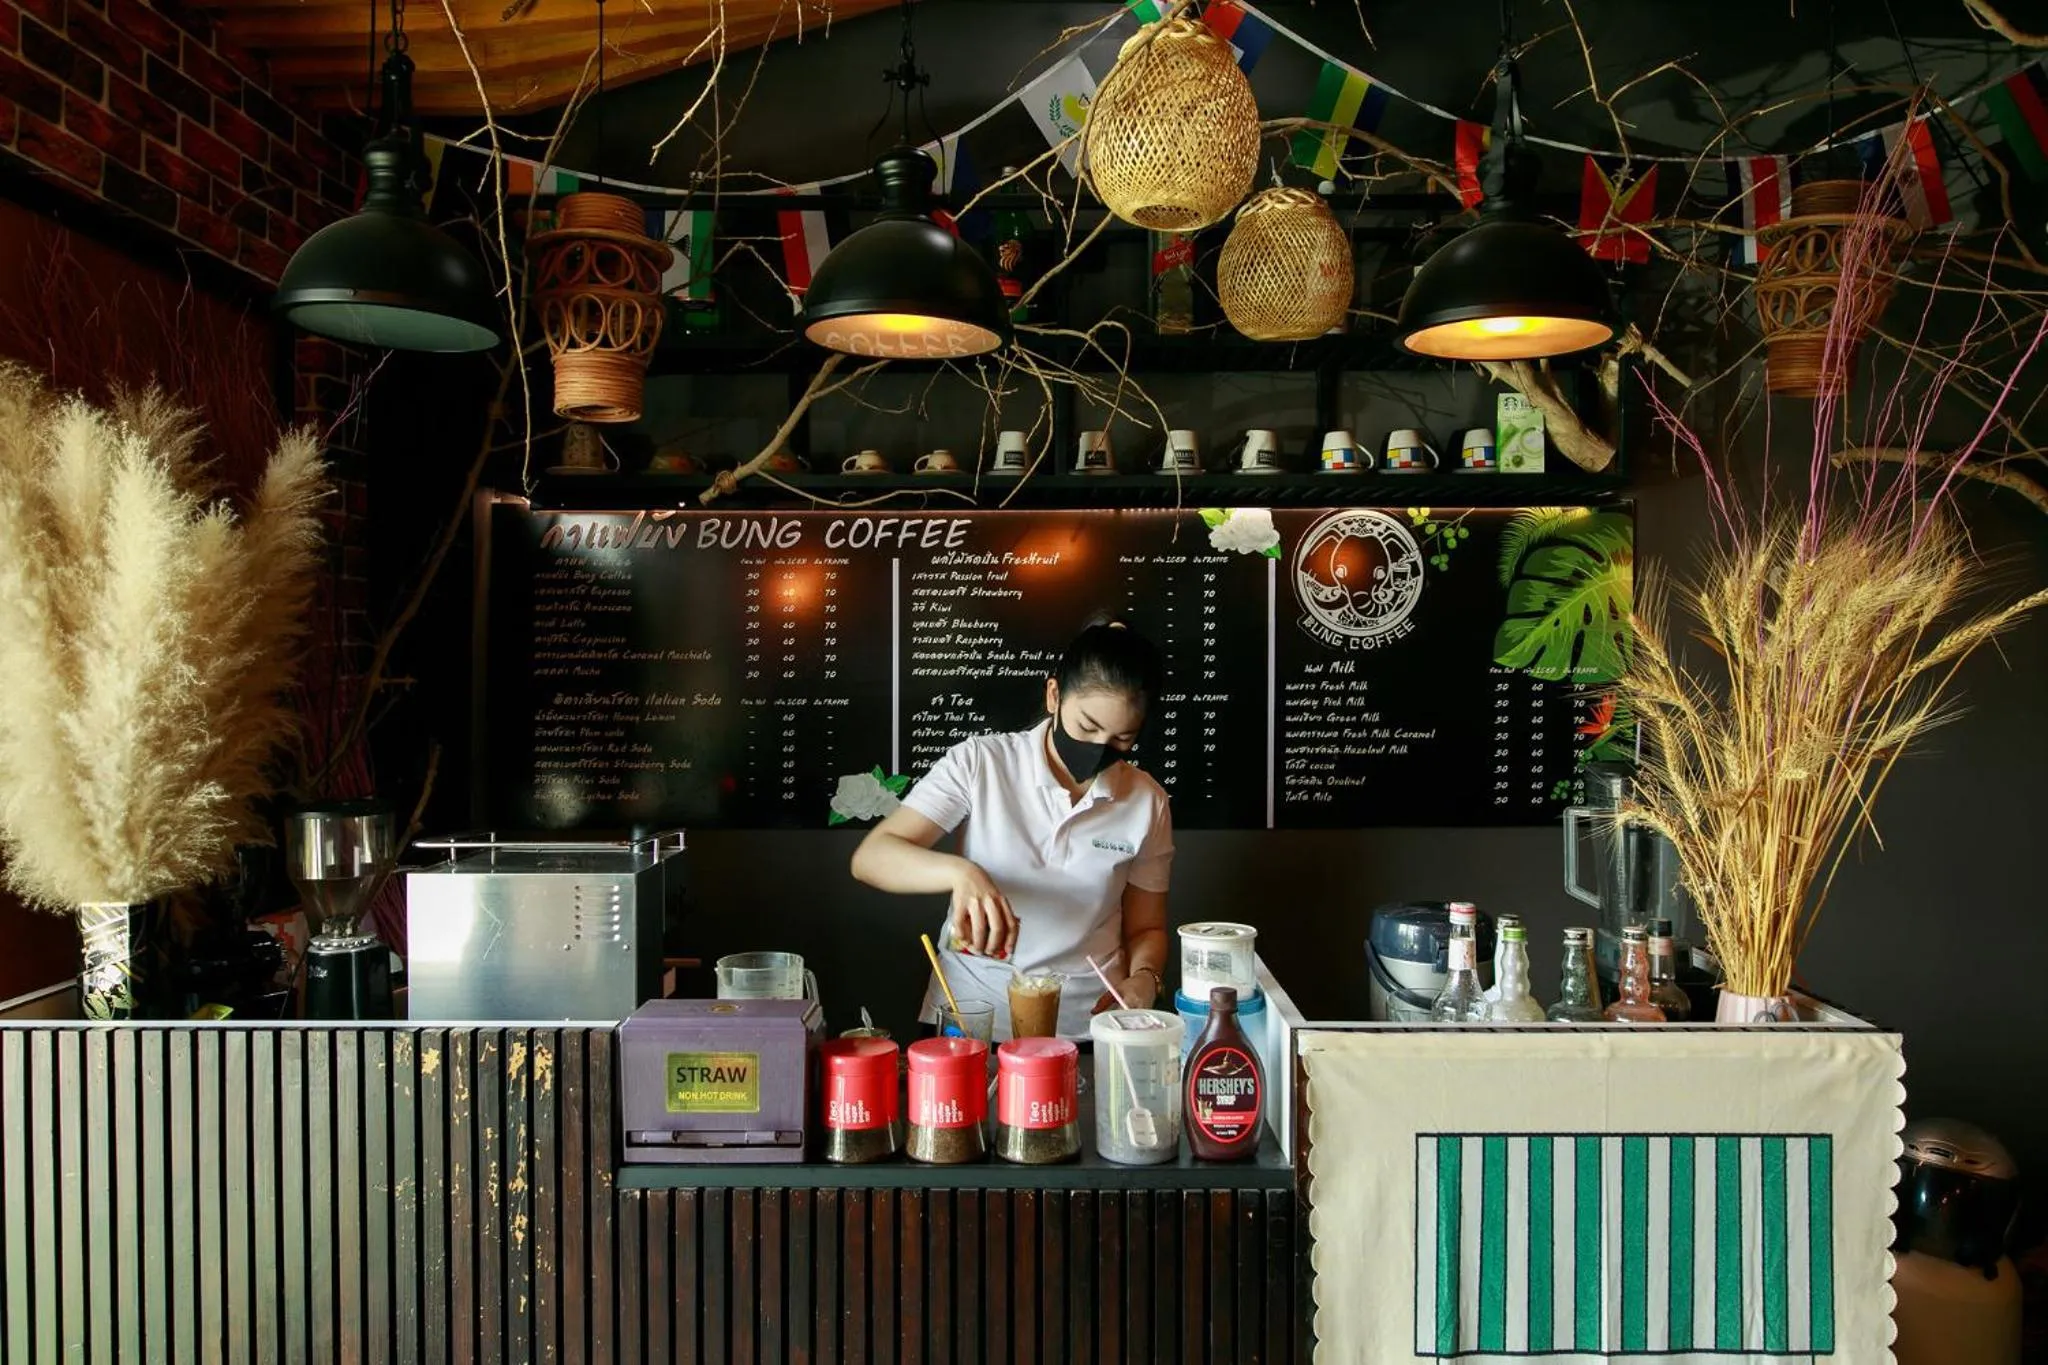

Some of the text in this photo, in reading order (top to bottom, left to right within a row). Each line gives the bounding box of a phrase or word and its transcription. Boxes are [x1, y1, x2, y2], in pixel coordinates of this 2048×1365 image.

[697, 518, 802, 550] BUNG
[826, 518, 972, 549] COFFEE
[950, 571, 982, 580] Passion
[970, 587, 1023, 600] Strawberry
[1203, 590, 1215, 598] 70
[930, 602, 952, 612] Kiwi
[1203, 606, 1215, 614] 70
[560, 618, 586, 628] Latte
[746, 621, 836, 629] 50 60 70
[951, 618, 998, 631] Blueberry
[1203, 622, 1215, 630] 70
[1302, 614, 1343, 646] BUNG
[1350, 618, 1416, 650] COFFEE
[746, 637, 836, 646] 50 60 70
[955, 634, 1003, 648] Raspberry
[1203, 638, 1215, 646] 70
[622, 650, 664, 660] Caramel
[746, 654, 836, 662] 50 60 70
[987, 650, 1015, 660] Snake
[1020, 651, 1042, 660] Fruit
[1046, 652, 1054, 660] in
[1330, 661, 1354, 673] Milk
[746, 670, 836, 679] 50 60 70
[997, 666, 1050, 680] Strawberry
[1203, 671, 1215, 679] 70
[1320, 681, 1367, 690] Fresh Milk
[692, 693, 721, 706] Soda
[951, 694, 973, 706] Tea
[1346, 697, 1365, 706] Milk
[782, 713, 795, 721] 60
[945, 712, 964, 721] Thai
[968, 712, 985, 721] Tea
[1327, 712, 1356, 722] Green
[1361, 712, 1379, 722] Milk
[1494, 716, 1509, 724] 50
[1532, 716, 1543, 724] 60
[782, 729, 795, 737] 60
[1164, 728, 1215, 736] 60 70
[1343, 728, 1435, 738] Fresh Milk Caramel
[782, 744, 795, 752] 60
[1164, 744, 1215, 752] 60 70
[1389, 745, 1408, 754] Milk
[1494, 749, 1509, 757] 50
[1532, 749, 1543, 757] 60
[782, 760, 795, 768] 60
[1164, 760, 1177, 768] 60
[782, 776, 795, 784] 60
[1164, 777, 1177, 785] 60
[1494, 782, 1509, 790] 50
[1532, 782, 1543, 790] 60
[782, 792, 795, 800] 60
[1313, 792, 1332, 801] Milo
[676, 1066, 748, 1084] STRAW
[1200, 1078, 1255, 1094] HERSHEY'S
[678, 1092, 747, 1100] NON HOT DRINK
